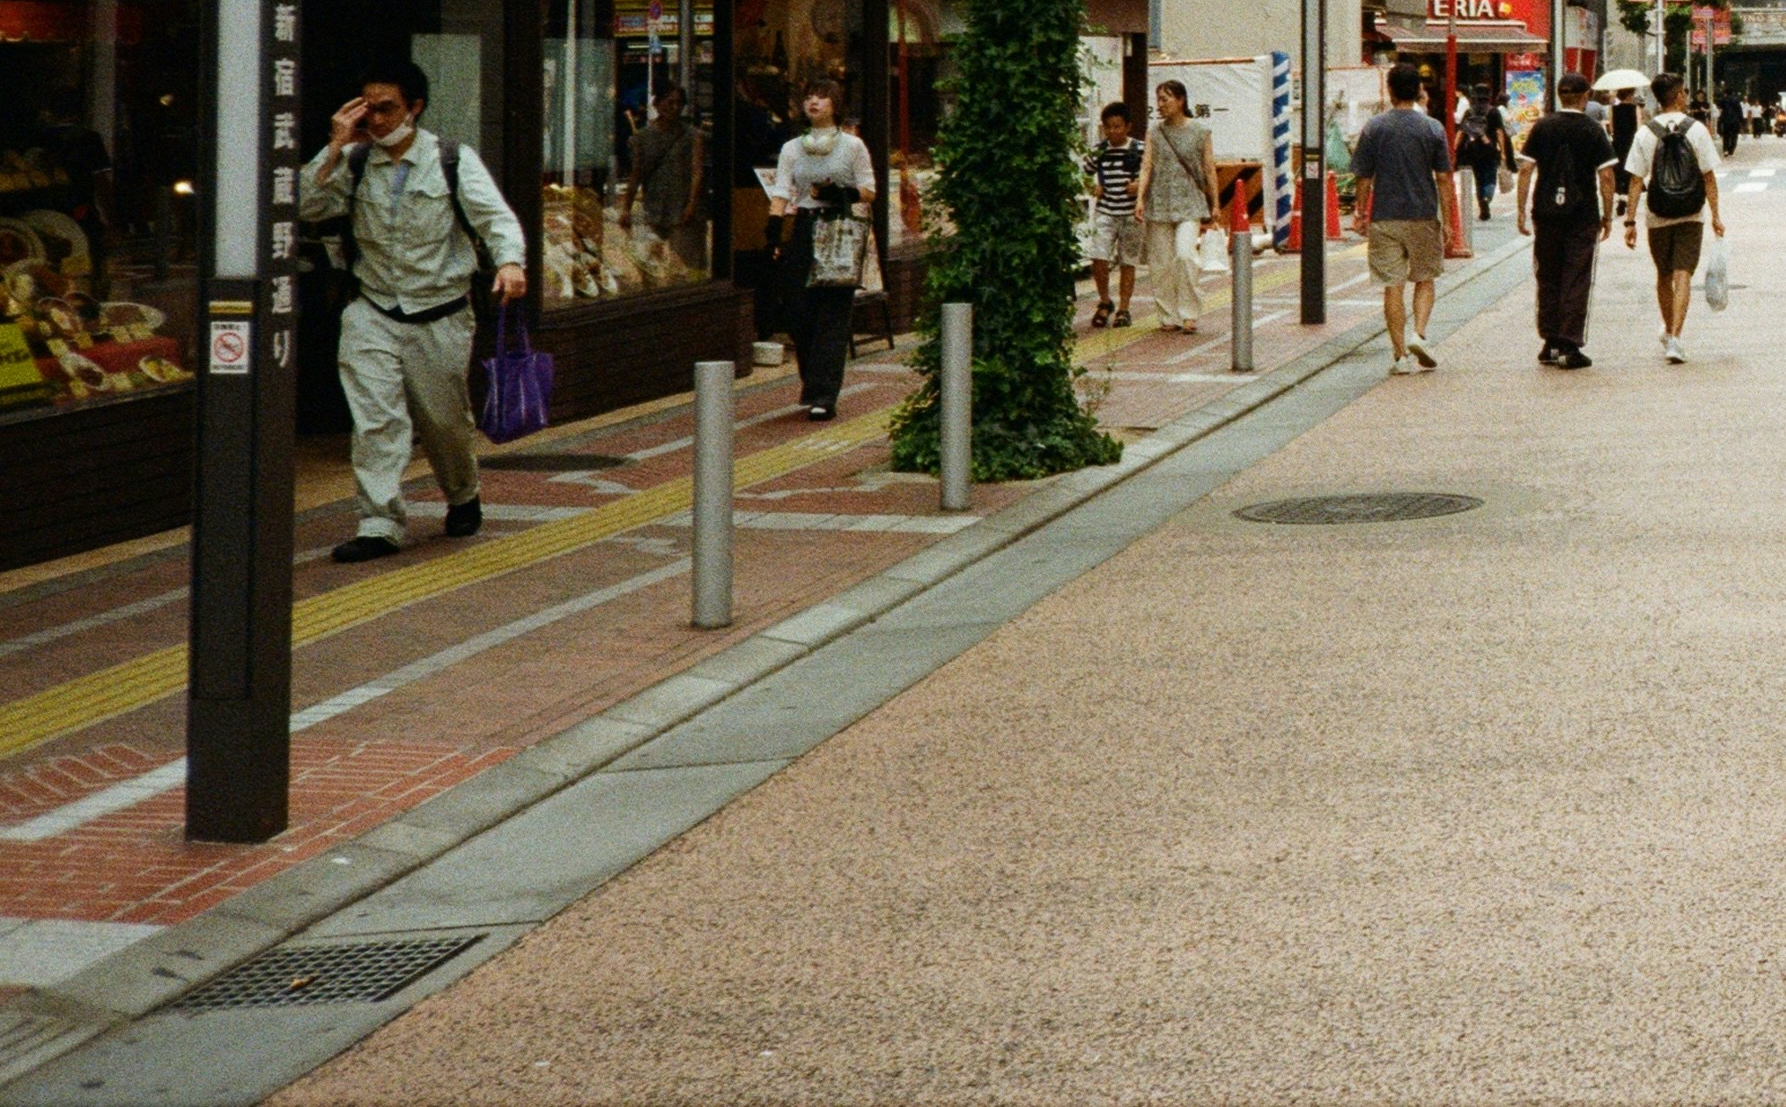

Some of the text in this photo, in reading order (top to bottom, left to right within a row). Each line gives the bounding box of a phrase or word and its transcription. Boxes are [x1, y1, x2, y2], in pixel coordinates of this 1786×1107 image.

[272, 4, 296, 368] 新宿武蔵野通り
